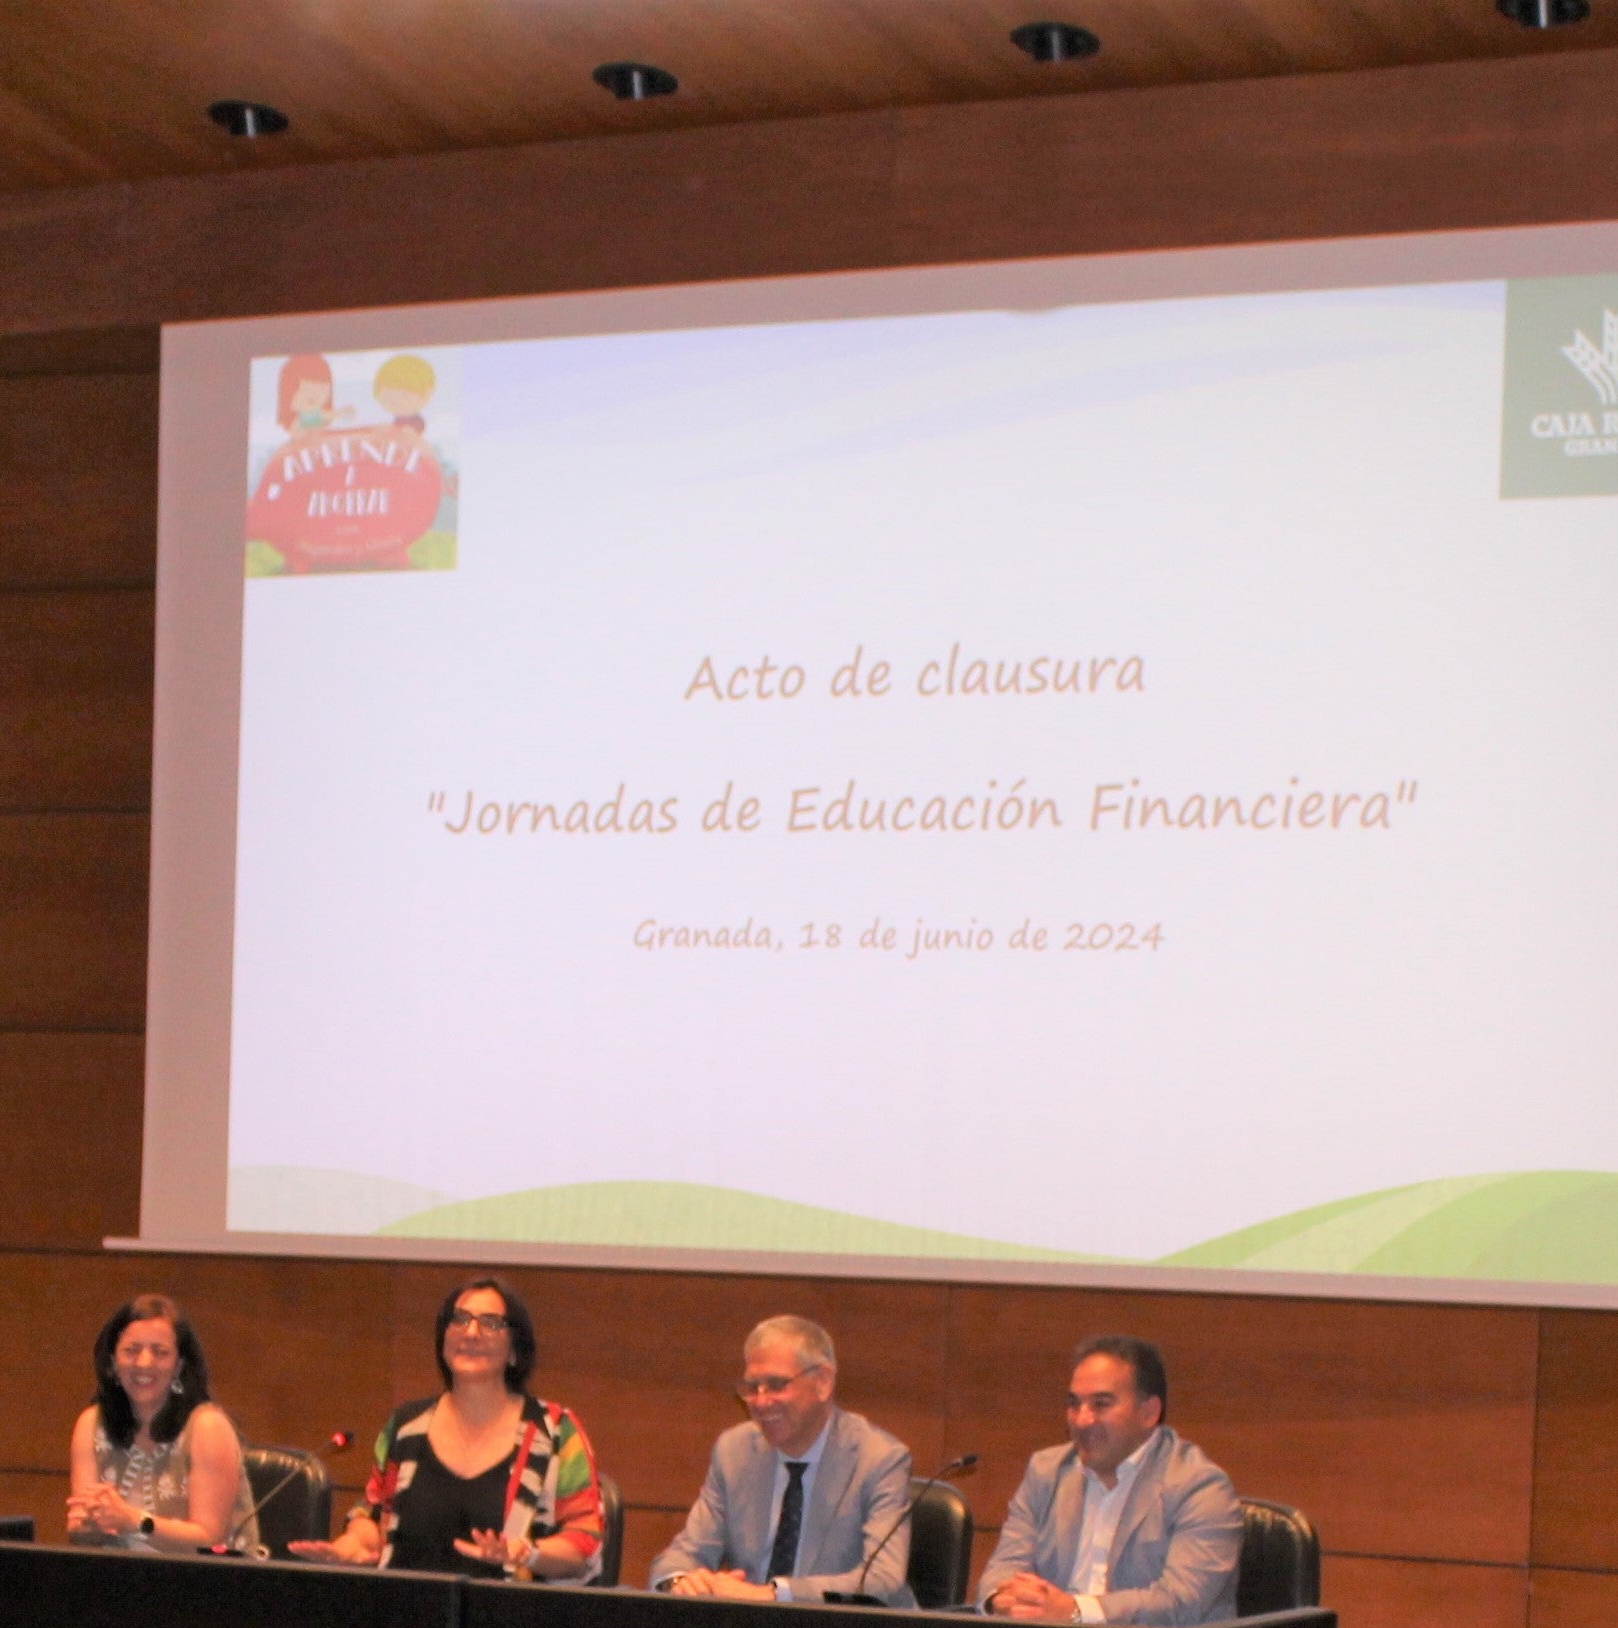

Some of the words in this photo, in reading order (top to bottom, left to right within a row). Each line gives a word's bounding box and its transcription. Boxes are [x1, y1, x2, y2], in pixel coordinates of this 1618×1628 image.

[1530, 411, 1597, 439] CAJA
[683, 654, 807, 701] Acto
[829, 643, 893, 698] de
[916, 641, 1147, 697] clausura
[427, 781, 680, 835] "Jornadas
[699, 783, 762, 834] de
[785, 779, 1063, 833] Educación
[1088, 776, 1418, 831] Financiera"
[632, 917, 786, 952] Granada,
[798, 921, 843, 950] 18
[858, 916, 899, 951] de
[905, 917, 995, 960] junio
[1007, 915, 1050, 951] de
[1062, 921, 1166, 951] 2024
